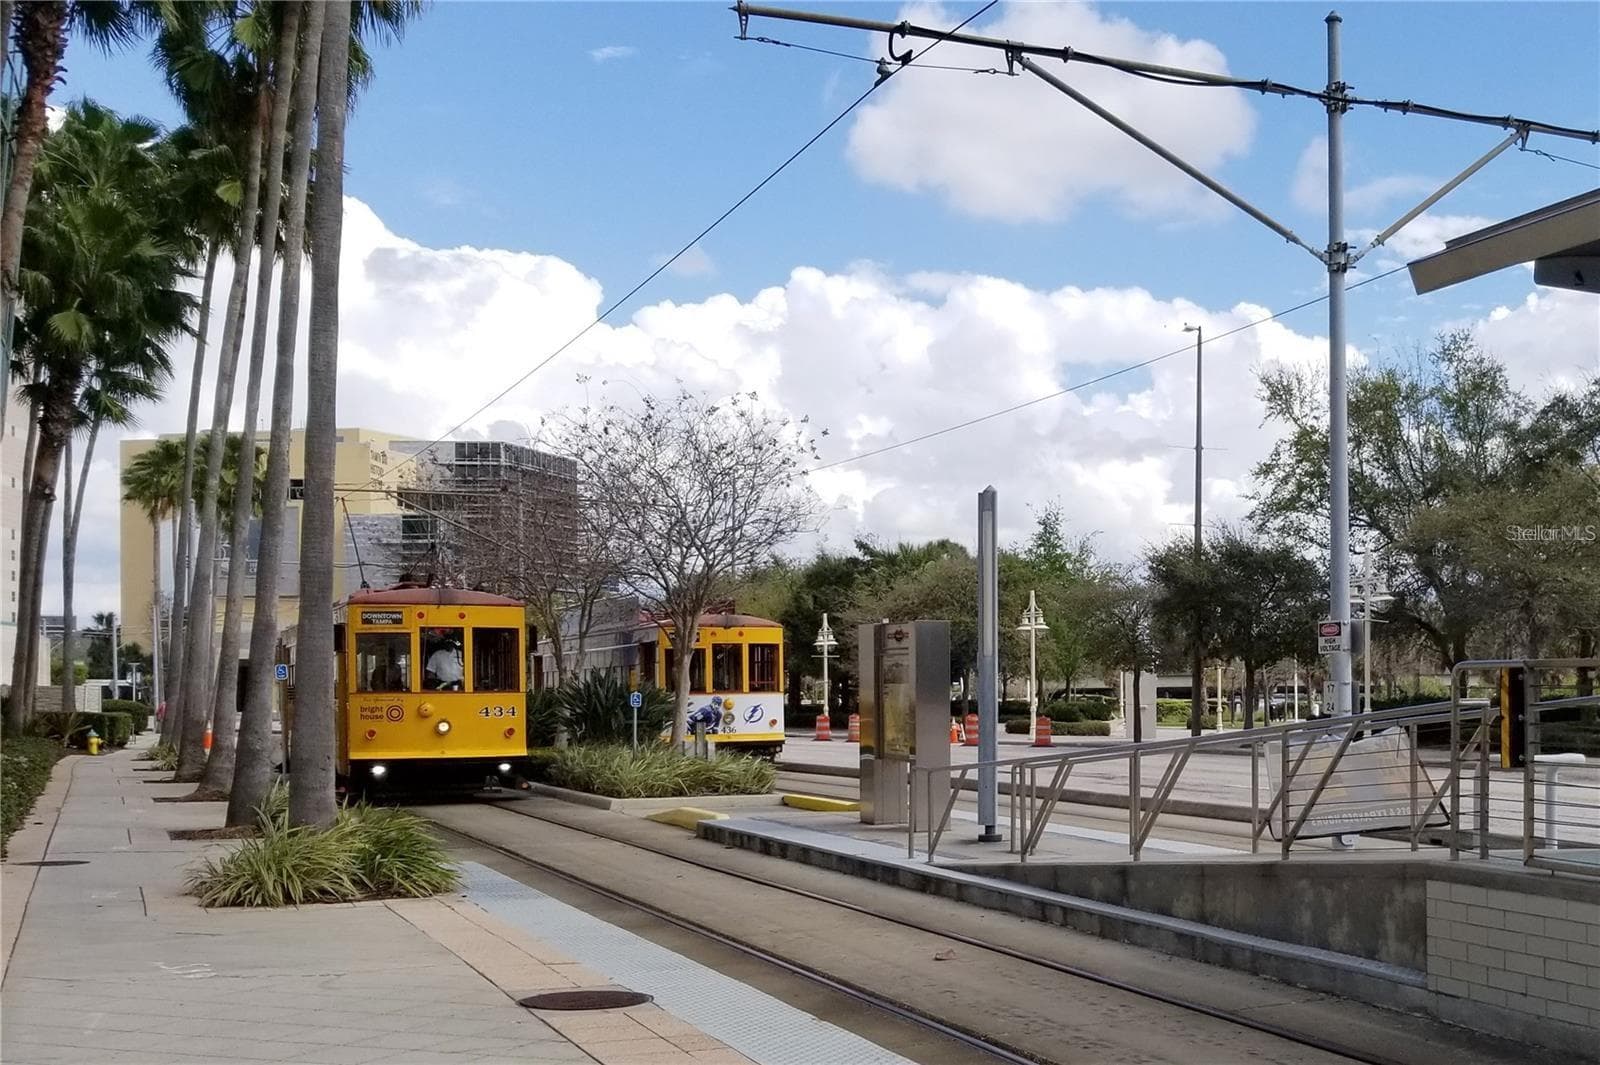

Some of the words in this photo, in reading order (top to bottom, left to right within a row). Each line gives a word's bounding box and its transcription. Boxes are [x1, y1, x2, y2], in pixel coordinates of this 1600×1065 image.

[362, 612, 402, 620] DOWNTOWN
[1320, 644, 1341, 652] VOLTAGE
[1327, 684, 1335, 693] 17
[360, 706, 384, 714] bright
[478, 704, 517, 718] 434
[1326, 702, 1335, 712] 24
[360, 713, 385, 721] house
[720, 726, 737, 734] 436
